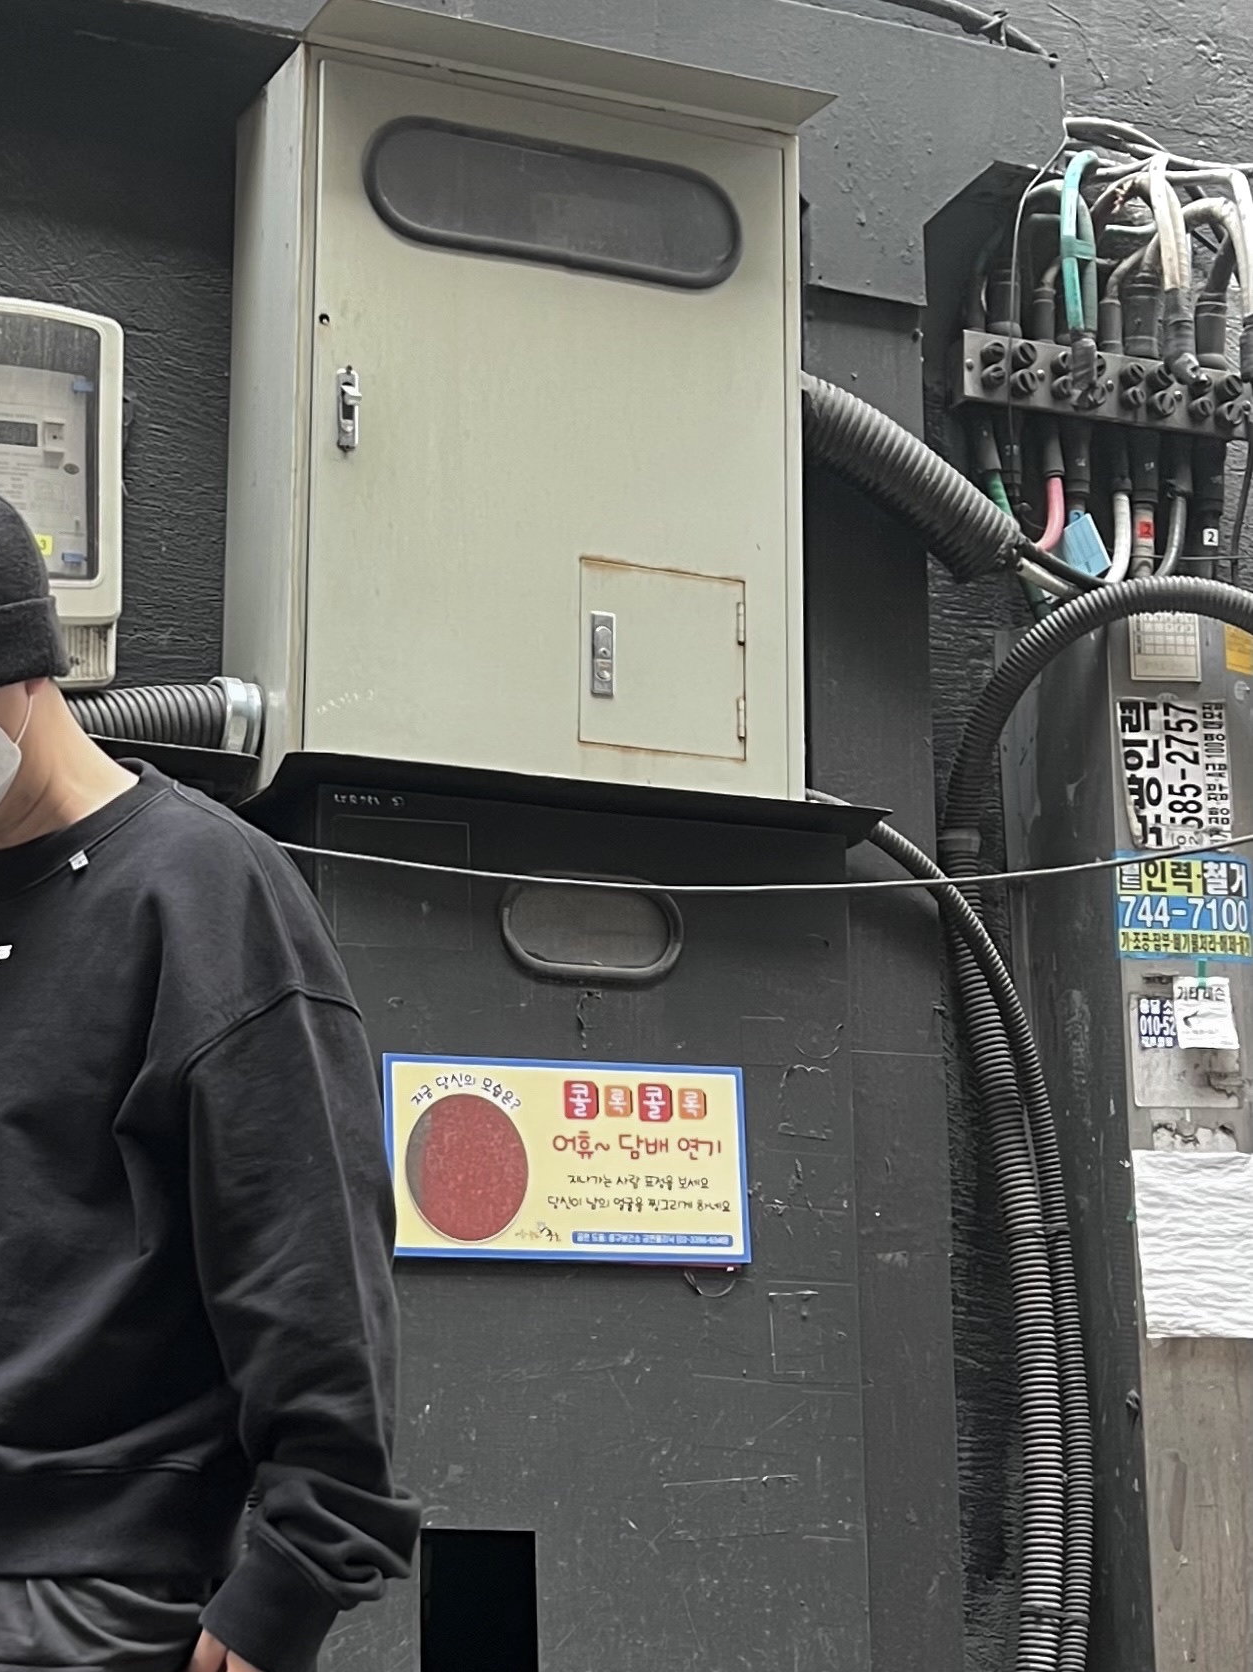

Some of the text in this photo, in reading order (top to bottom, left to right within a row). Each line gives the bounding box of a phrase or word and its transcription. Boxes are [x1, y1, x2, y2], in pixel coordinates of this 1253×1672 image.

[1207, 532, 1215, 544] 2
[1119, 896, 1248, 931] 744-7100
[410, 1073, 522, 1110] 지금 당신의 모습은?
[618, 1133, 669, 1160] 담배
[677, 1136, 722, 1161] 연기
[567, 1174, 710, 1191] 지나가는 사람 표정을 보세요
[547, 1195, 583, 1210] 당신이
[613, 1197, 644, 1213] 얼굴을
